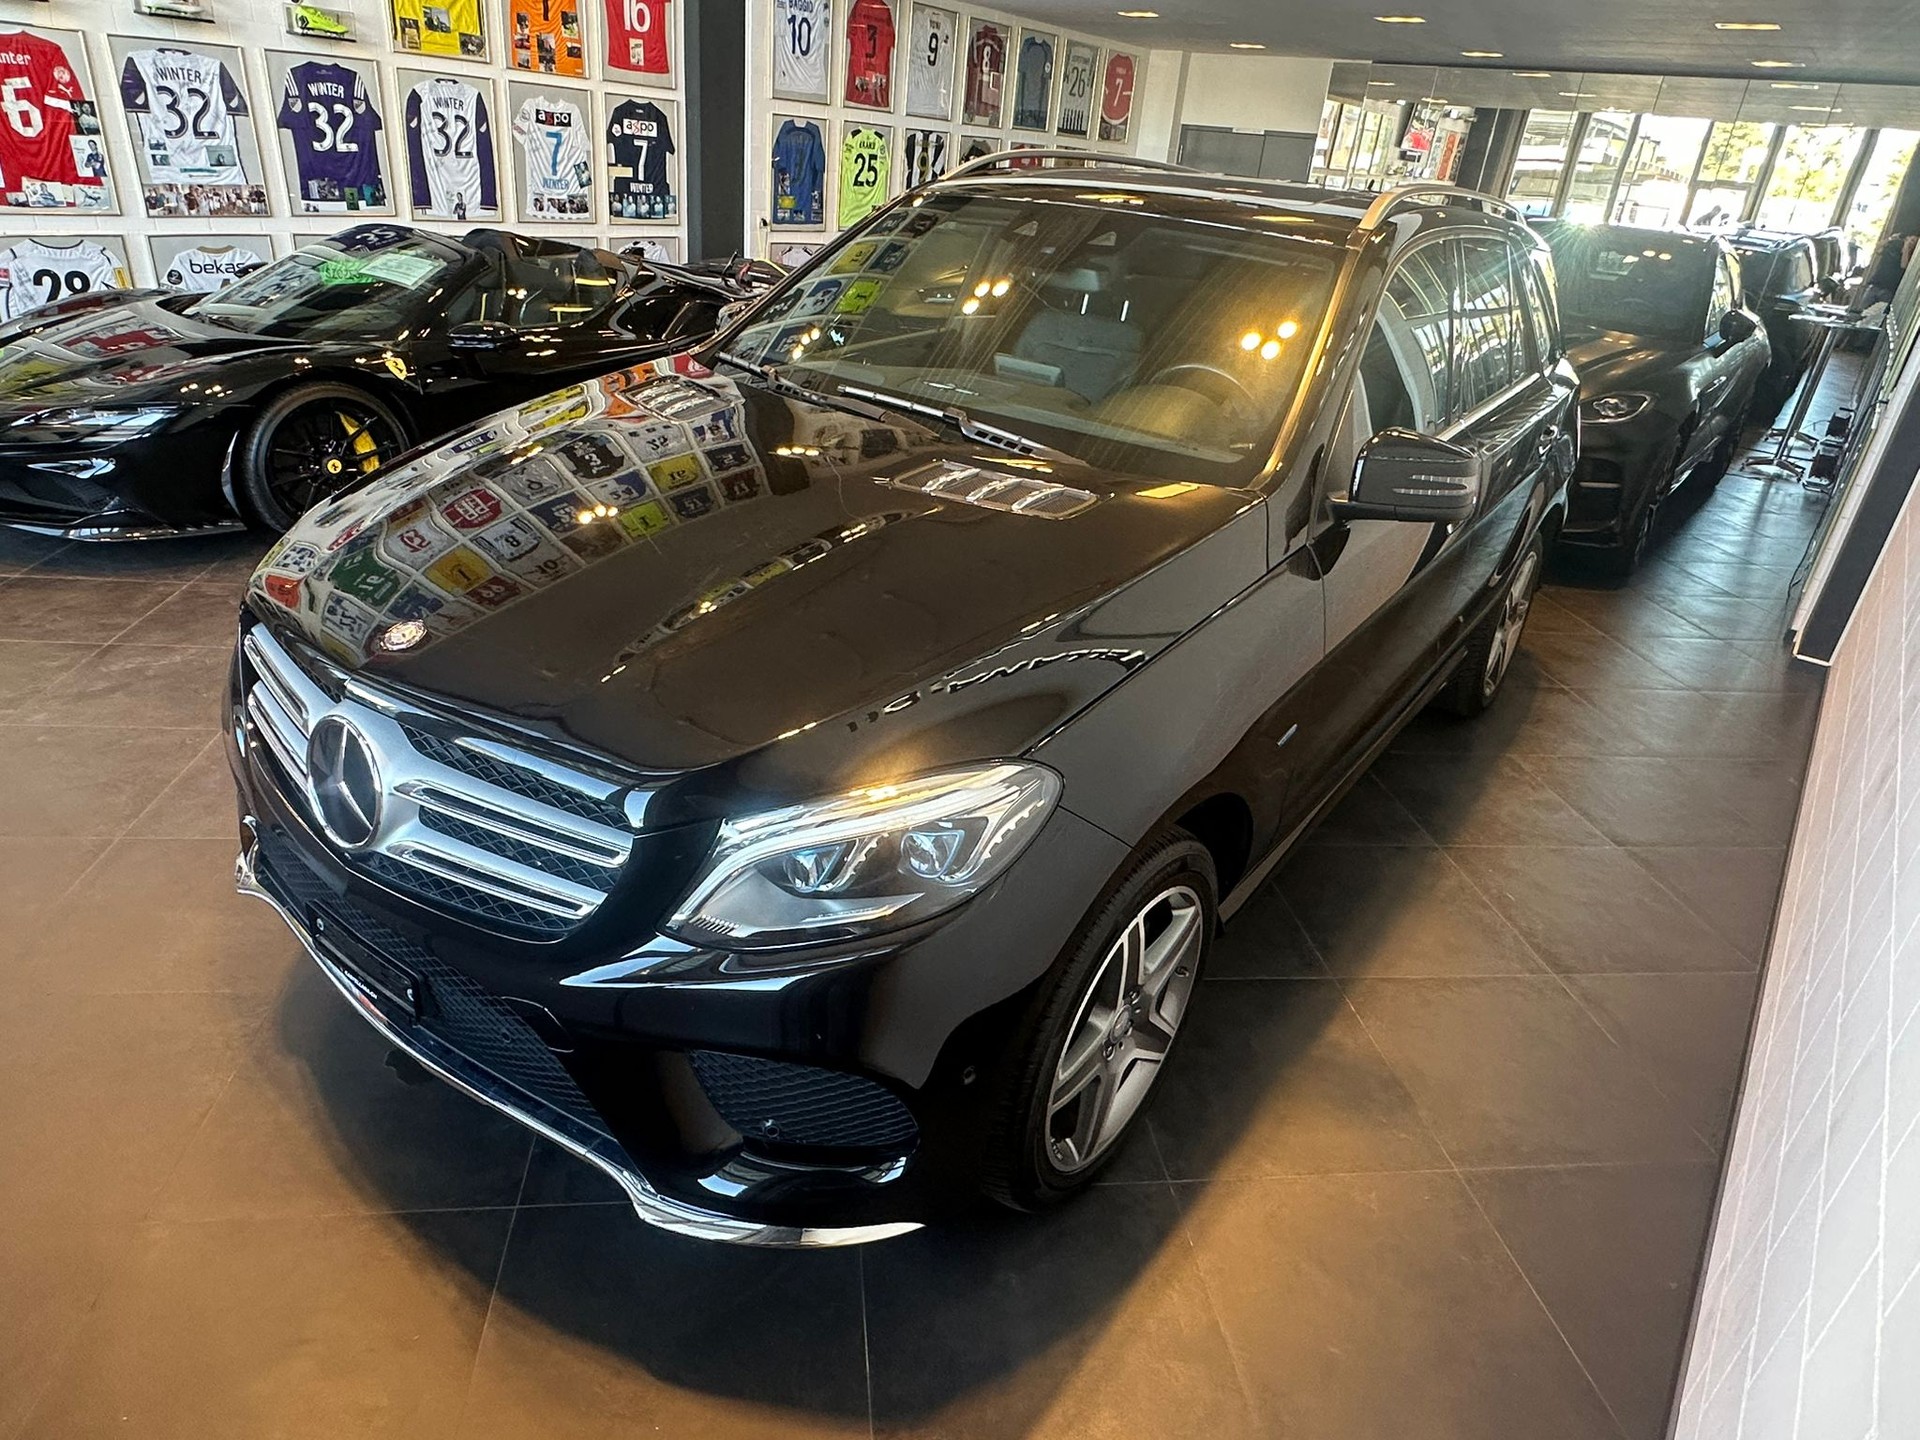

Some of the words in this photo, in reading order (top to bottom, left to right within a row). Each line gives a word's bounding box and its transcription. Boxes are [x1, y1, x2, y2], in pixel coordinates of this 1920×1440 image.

[623, 0, 651, 33] 16
[788, 14, 811, 56] 10
[867, 24, 878, 58] 3
[927, 32, 939, 67] 9
[156, 67, 202, 84] WINTER
[307, 82, 344, 99] WINTER
[1068, 66, 1086, 98] 26
[1114, 78, 1124, 107] 7
[0, 76, 44, 138] 6
[156, 85, 220, 139] 32
[433, 97, 465, 111] WINTER
[307, 102, 359, 152] 32
[432, 112, 474, 158] 32
[545, 131, 563, 177] 7
[633, 139, 649, 181] 7
[852, 153, 878, 188] 25
[33, 268, 91, 304] 28
